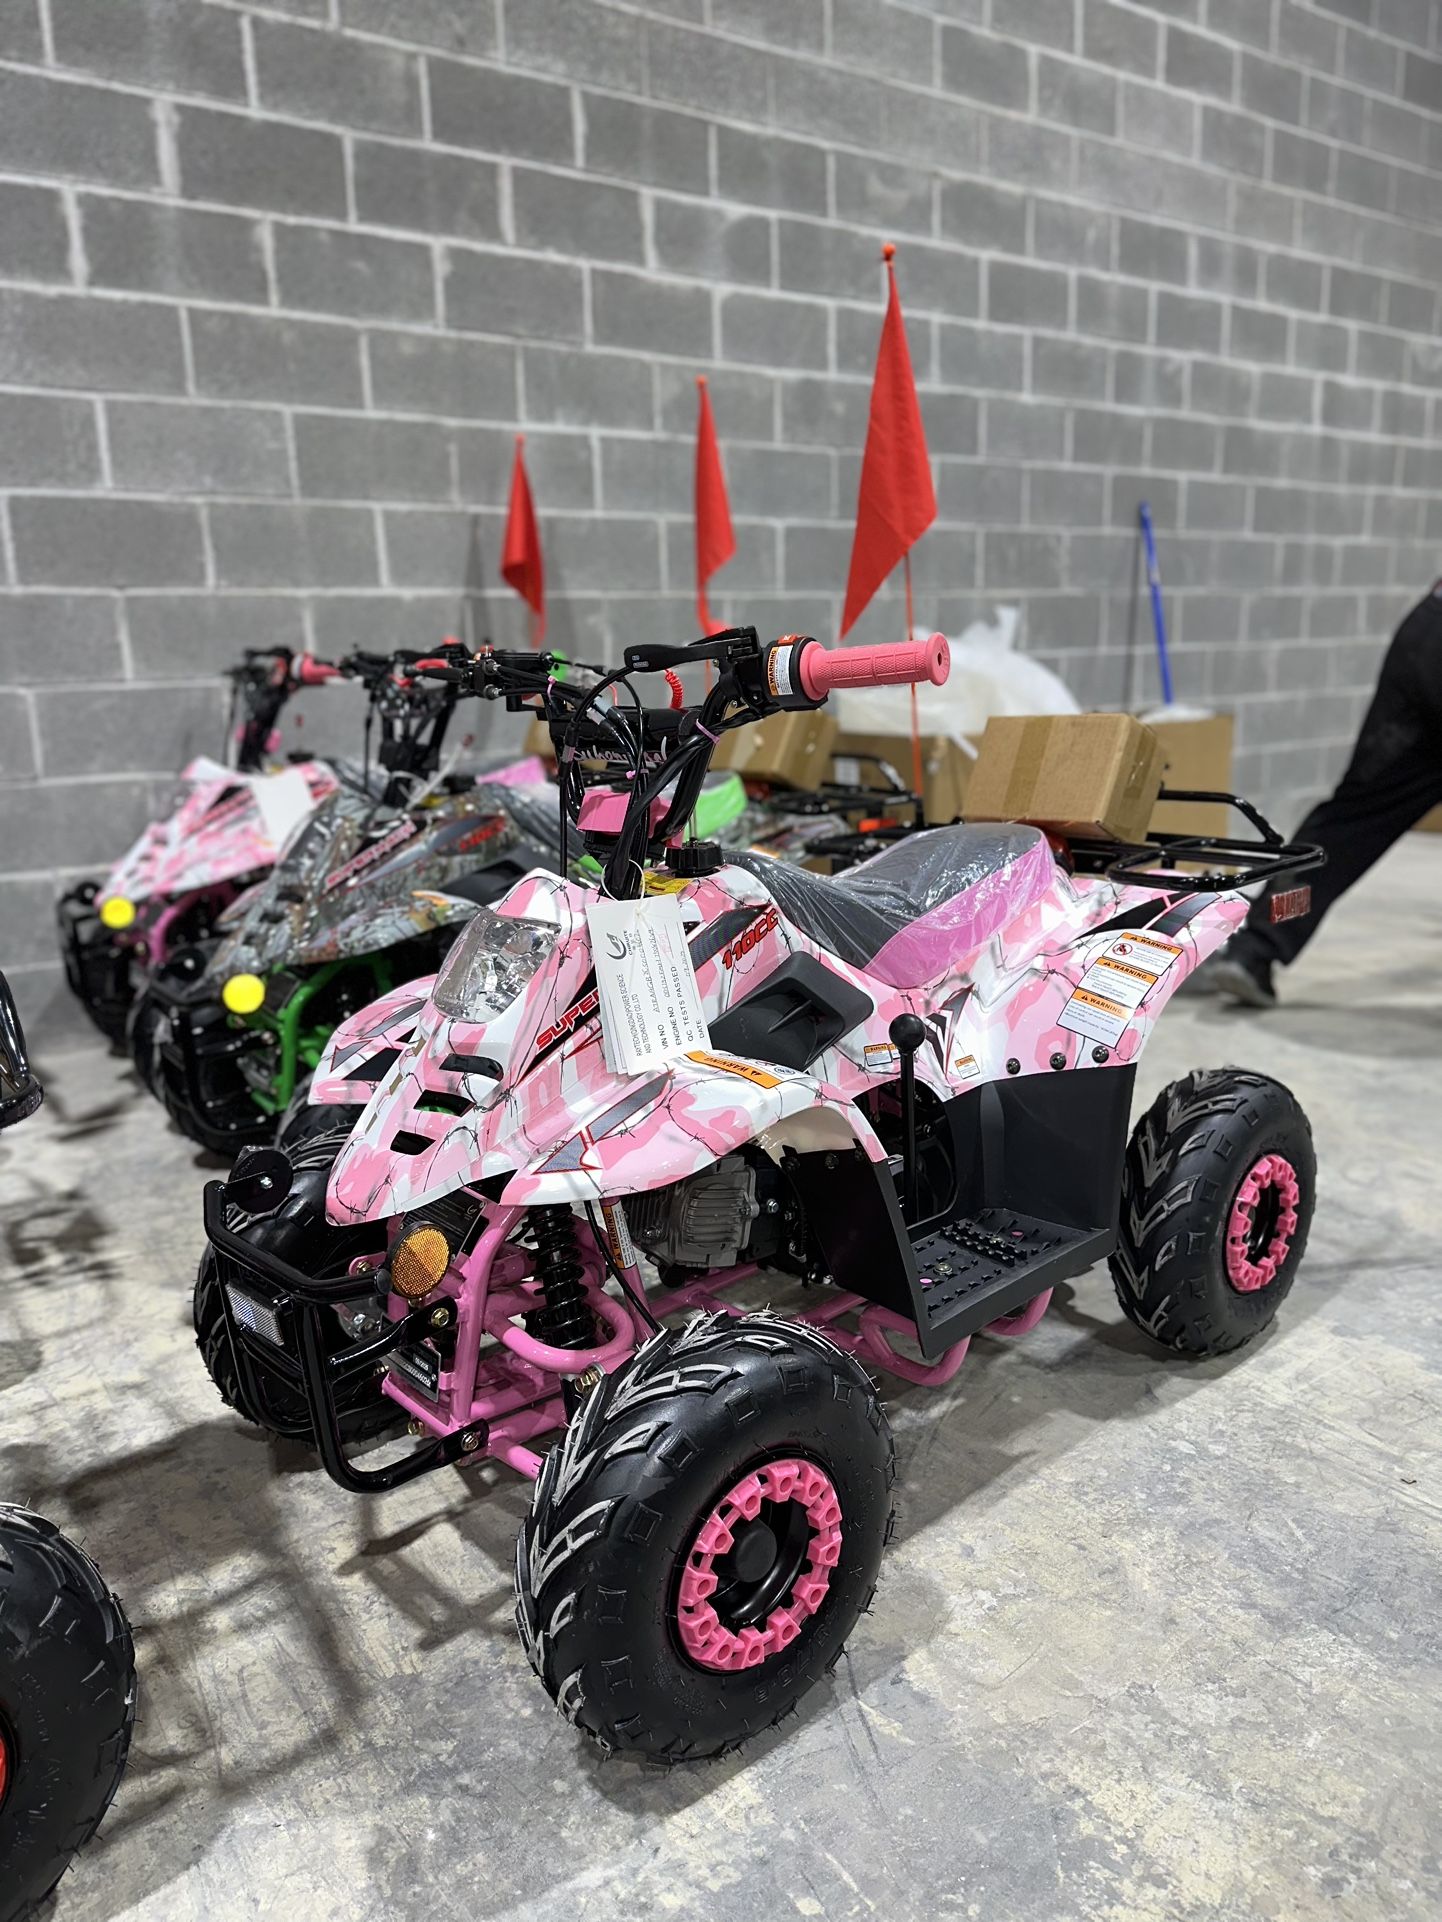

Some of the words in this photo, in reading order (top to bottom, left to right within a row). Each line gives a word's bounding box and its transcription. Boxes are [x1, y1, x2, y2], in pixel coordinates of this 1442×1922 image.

[769, 650, 777, 684] WARNING
[722, 907, 780, 970] 110CC
[1140, 938, 1173, 951] WARNING
[1113, 963, 1148, 980] WARNING
[671, 966, 683, 998] PASSED
[667, 1006, 675, 1018] NO
[679, 1001, 690, 1026] TESTS
[1090, 997, 1124, 1015] WARNING
[657, 1024, 665, 1036] NO
[671, 1019, 682, 1046] ENGINE
[686, 1030, 694, 1042] QC
[696, 1020, 705, 1039] DATE
[661, 1037, 669, 1050] VIN
[704, 1057, 749, 1072] WARNING
[606, 1213, 620, 1250] WARNING
